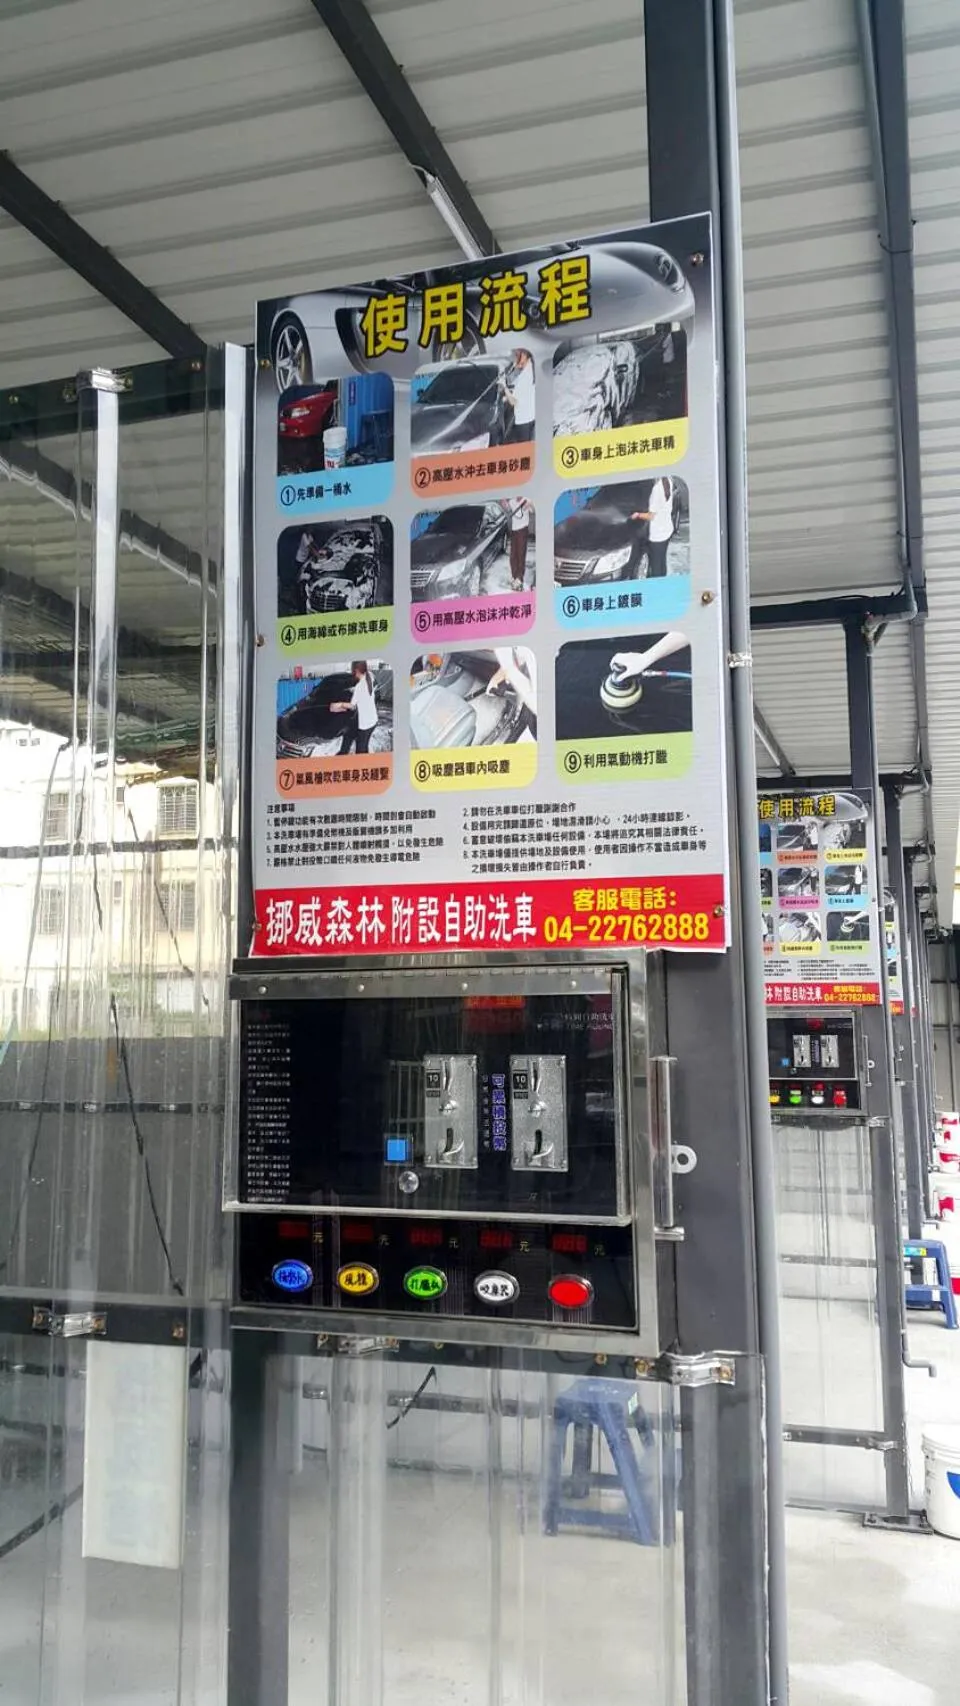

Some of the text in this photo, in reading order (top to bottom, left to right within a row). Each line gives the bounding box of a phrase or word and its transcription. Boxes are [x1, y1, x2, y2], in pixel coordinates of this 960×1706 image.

[361, 254, 592, 358] 使用流程
[759, 795, 836, 819] 使用流程
[544, 912, 709, 943] 04-22762888
[515, 1075, 526, 1083] 10
[313, 1232, 323, 1243] 元
[520, 1241, 530, 1252] 元
